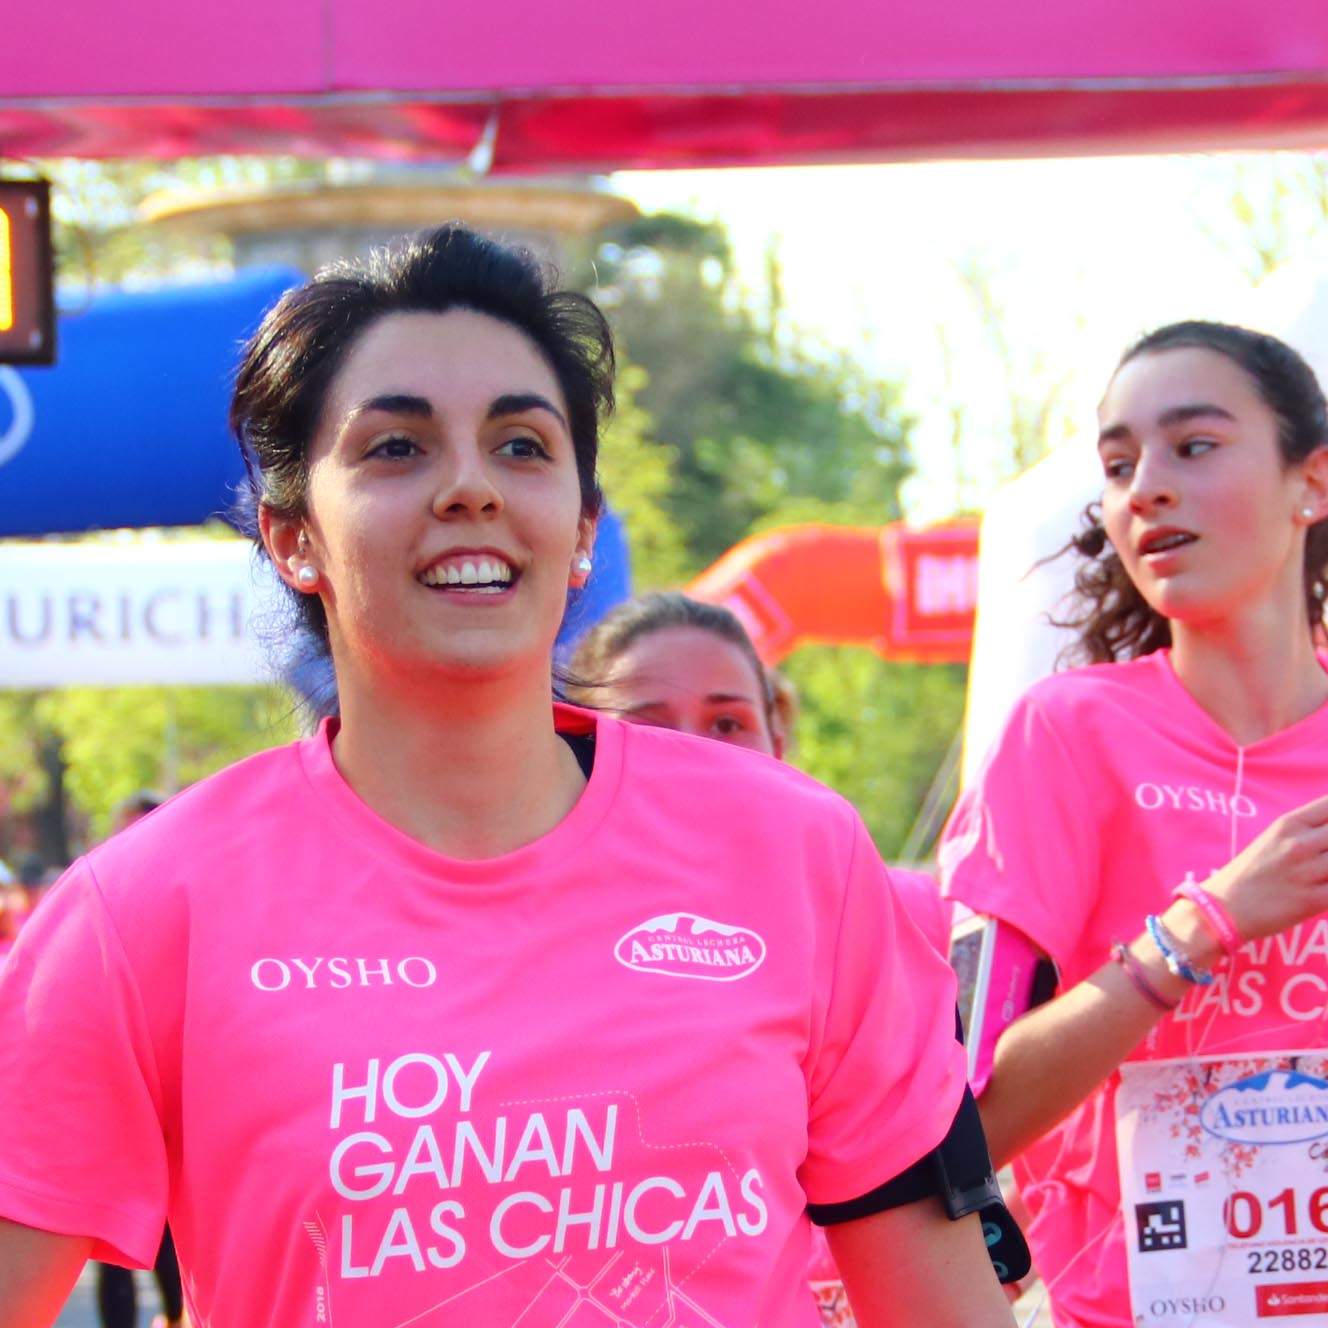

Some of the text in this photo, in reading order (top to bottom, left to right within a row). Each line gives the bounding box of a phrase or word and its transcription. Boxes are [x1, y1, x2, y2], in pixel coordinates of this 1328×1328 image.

[1135, 782, 1257, 817] OYSHO
[629, 939, 757, 967] ASTURIANA
[249, 954, 438, 992] OYSHO
[329, 1050, 492, 1130] HOY
[329, 1103, 619, 1202] GANAN
[340, 1166, 768, 1280] LAS CHICAS
[1150, 1295, 1226, 1318] OYSHO
